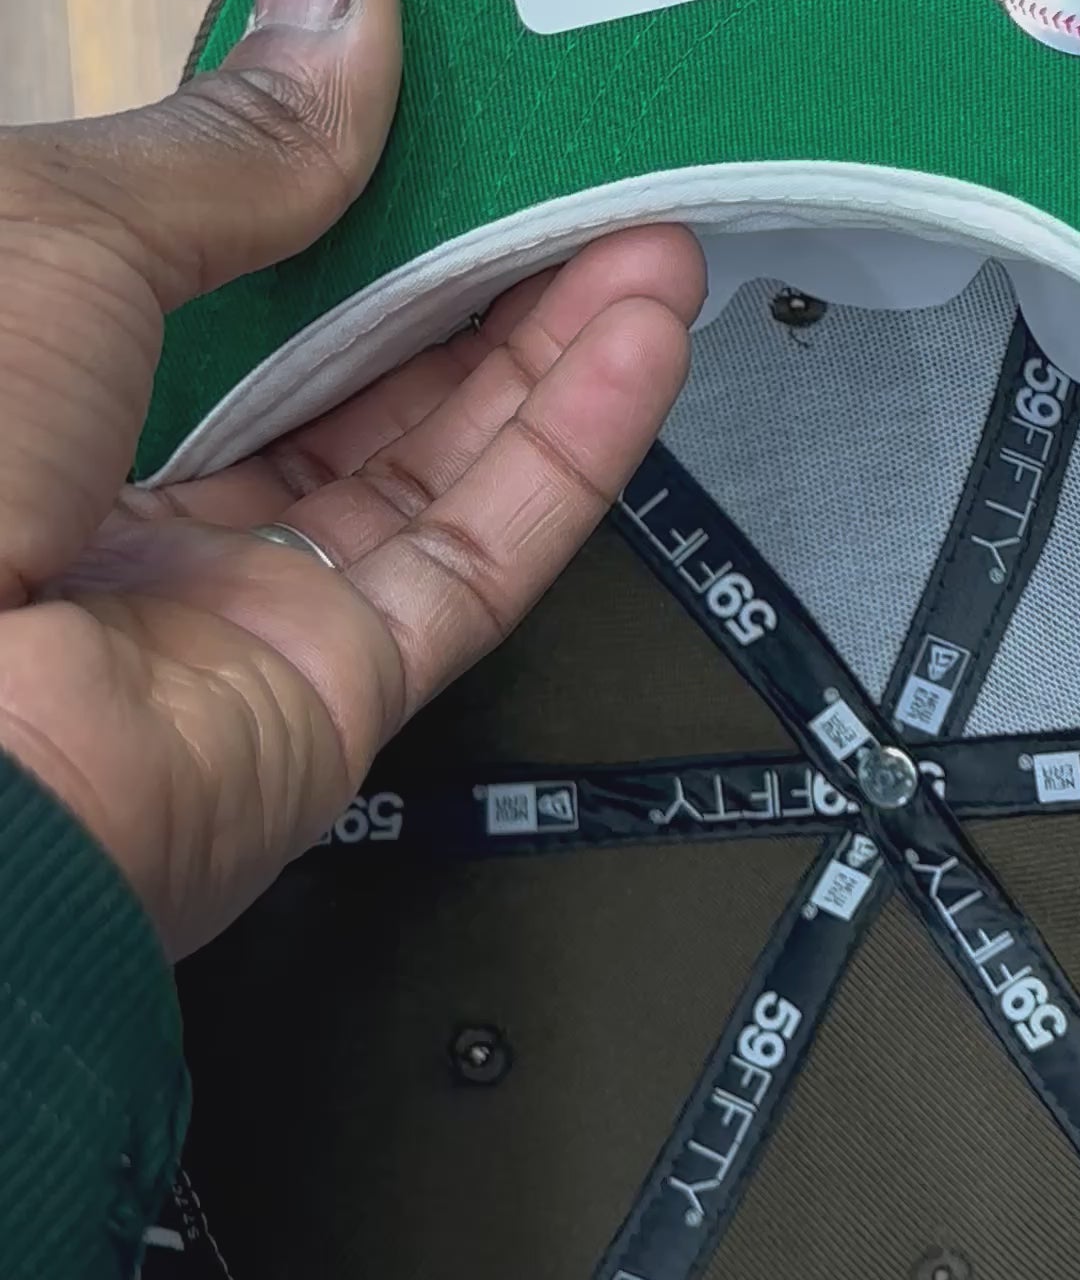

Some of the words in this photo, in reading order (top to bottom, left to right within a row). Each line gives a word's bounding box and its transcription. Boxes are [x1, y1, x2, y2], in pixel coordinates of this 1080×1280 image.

[971, 356, 1071, 572] 59FIFTY
[618, 487, 777, 647] 59FIFT
[495, 807, 529, 821] NEW
[1042, 763, 1074, 779] ERA
[1044, 776, 1076, 791] NEW
[914, 855, 1068, 1051] 59FIFTY
[668, 991, 802, 1214] 59FIFTY
